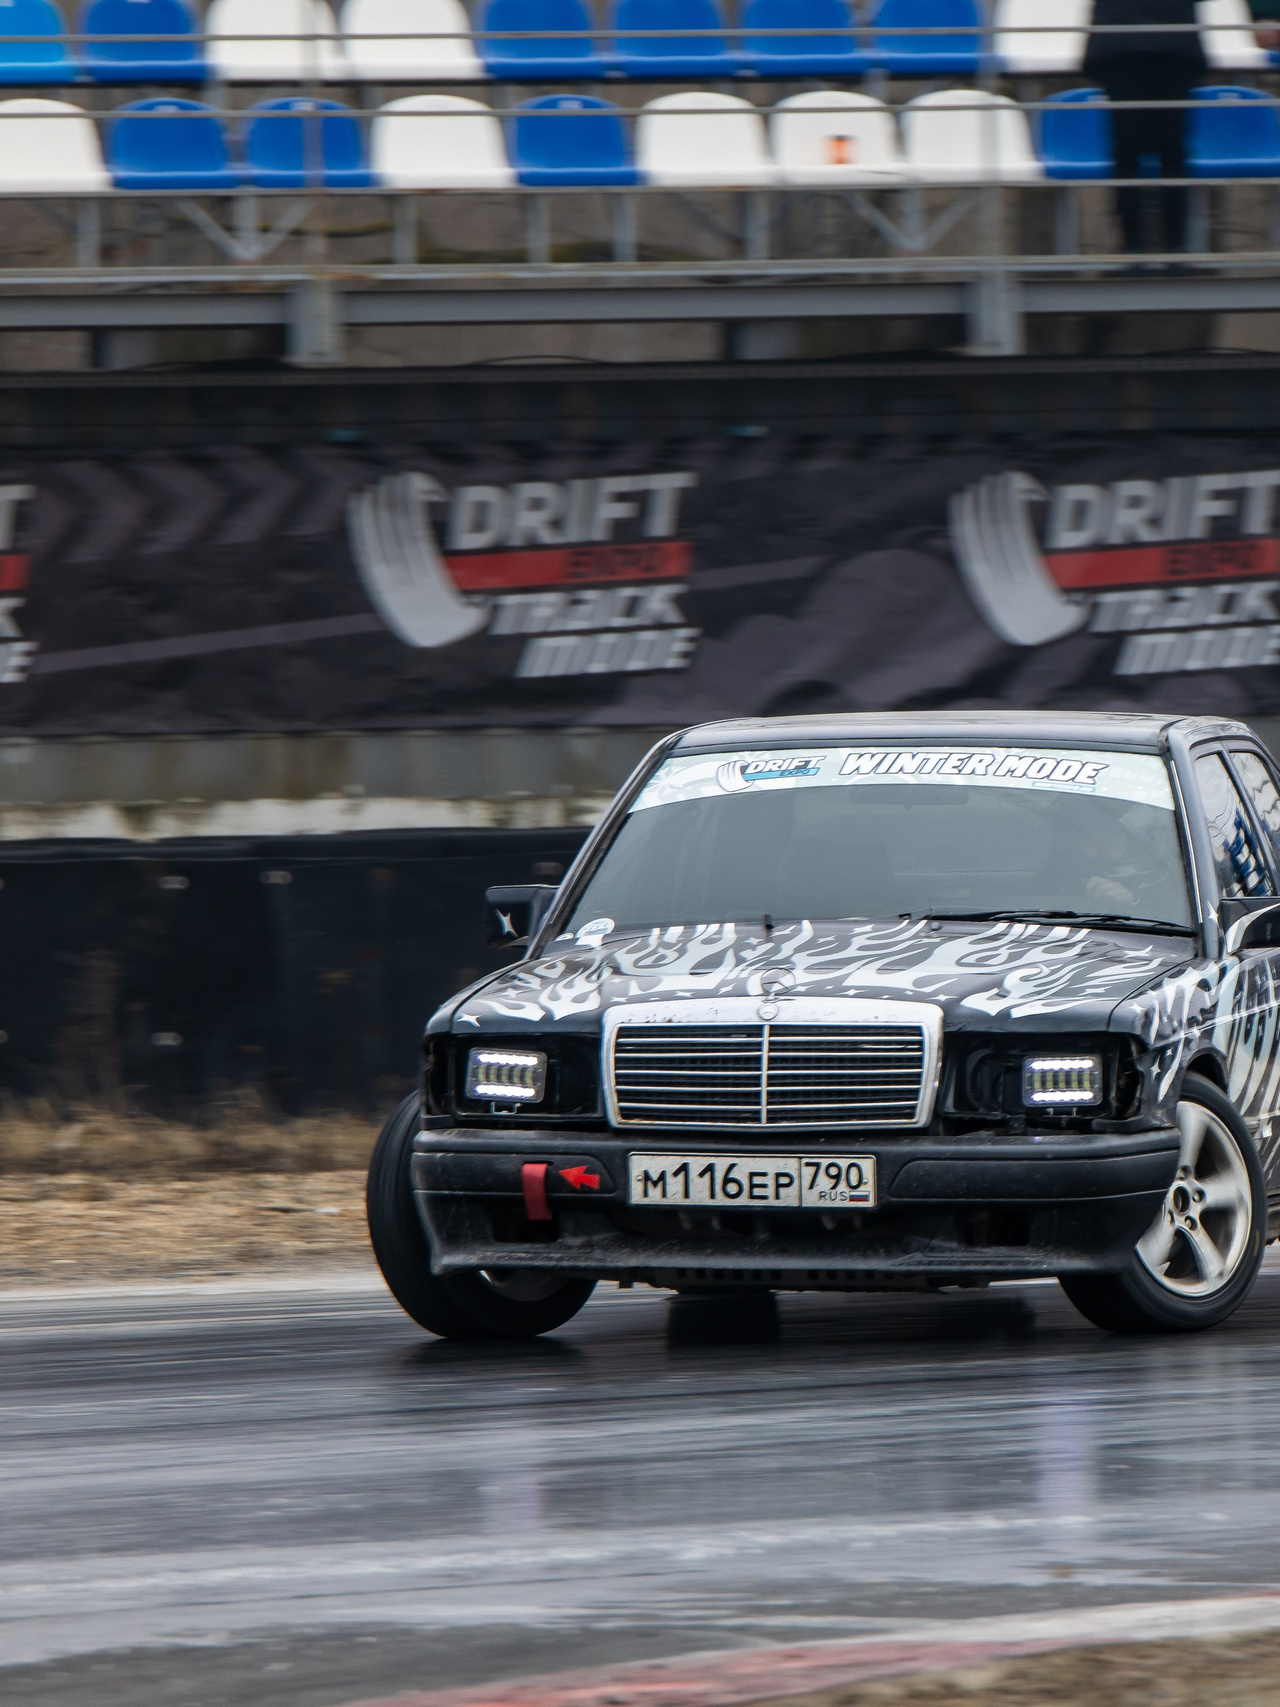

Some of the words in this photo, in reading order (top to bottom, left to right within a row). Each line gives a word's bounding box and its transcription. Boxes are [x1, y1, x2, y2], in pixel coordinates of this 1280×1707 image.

[445, 471, 699, 551] DRIFT
[745, 755, 827, 775] DRIFT
[838, 752, 996, 776] WINTER
[993, 754, 1109, 784] MODE
[804, 1161, 864, 1191] 790
[818, 1190, 848, 1202] RUS
